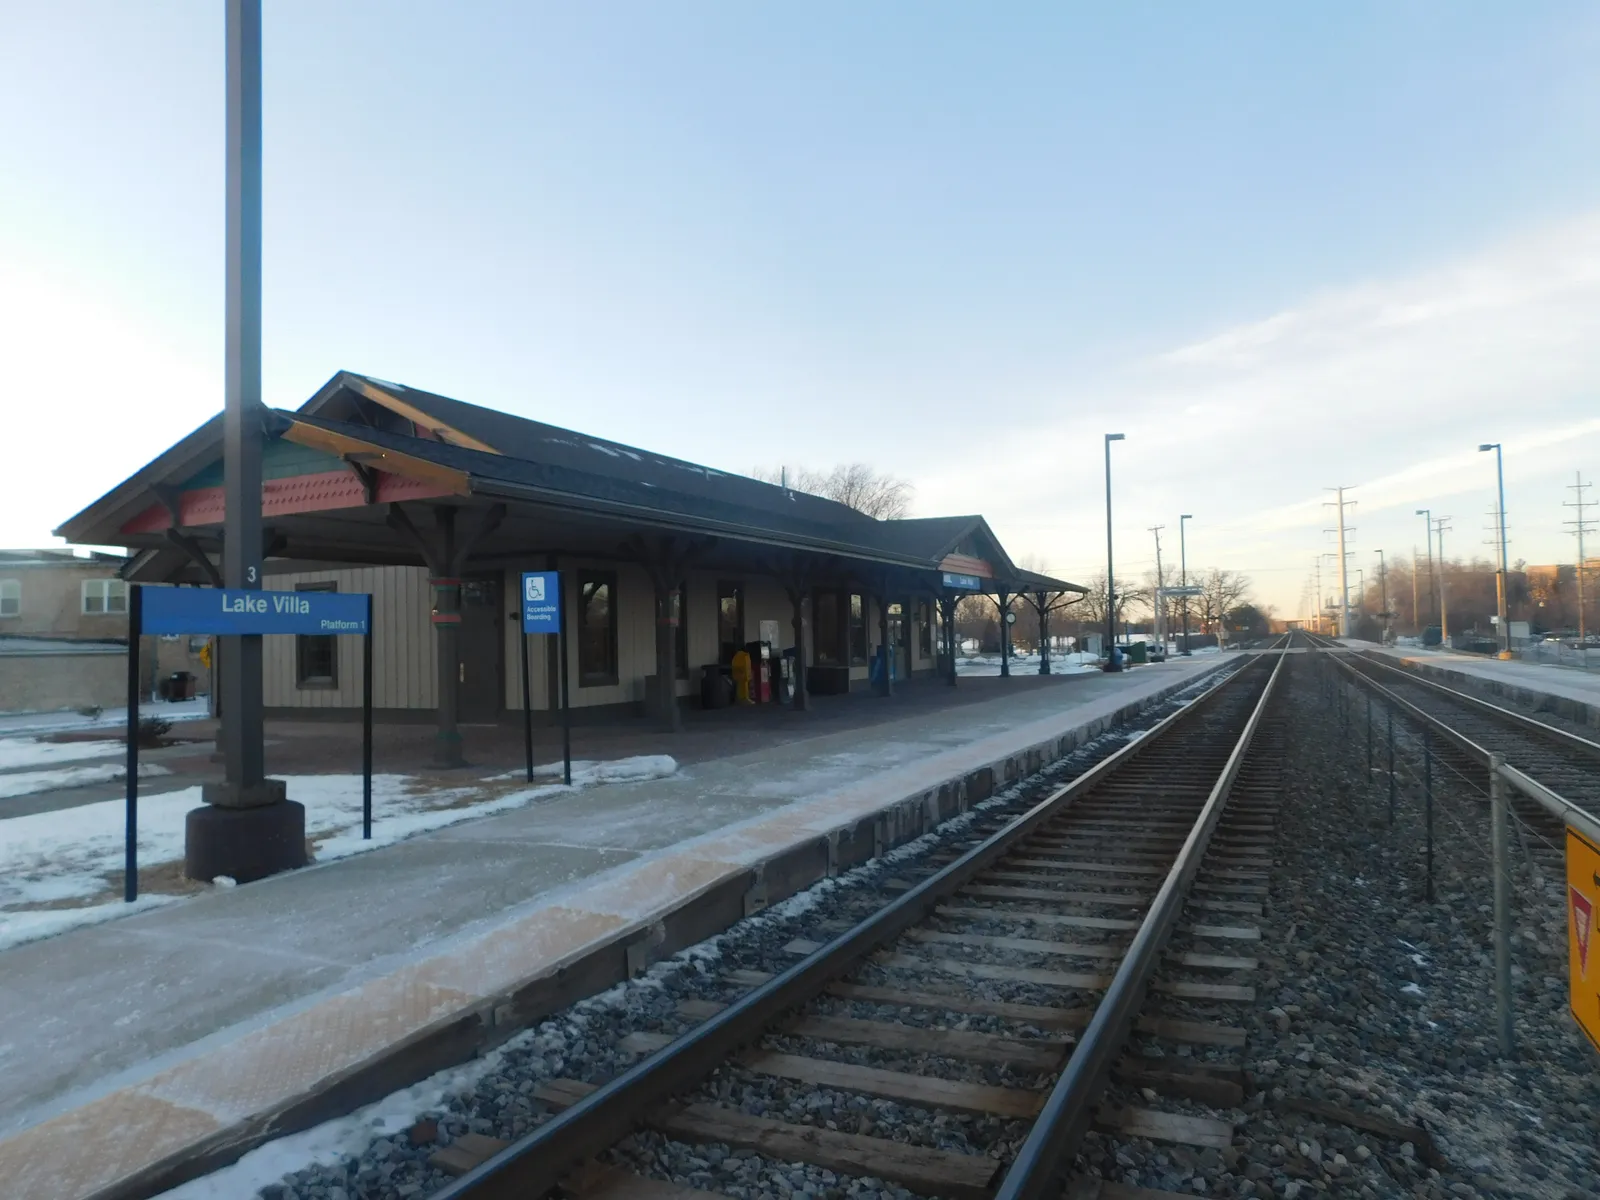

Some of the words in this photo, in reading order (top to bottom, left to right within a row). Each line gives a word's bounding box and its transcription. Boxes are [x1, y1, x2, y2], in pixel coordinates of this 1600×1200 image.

[247, 566, 257, 583] 3
[222, 594, 268, 613] Lake
[273, 596, 311, 614] Villa
[526, 613, 551, 621] Boarding
[321, 620, 359, 631] Platform
[362, 620, 367, 631] 1
